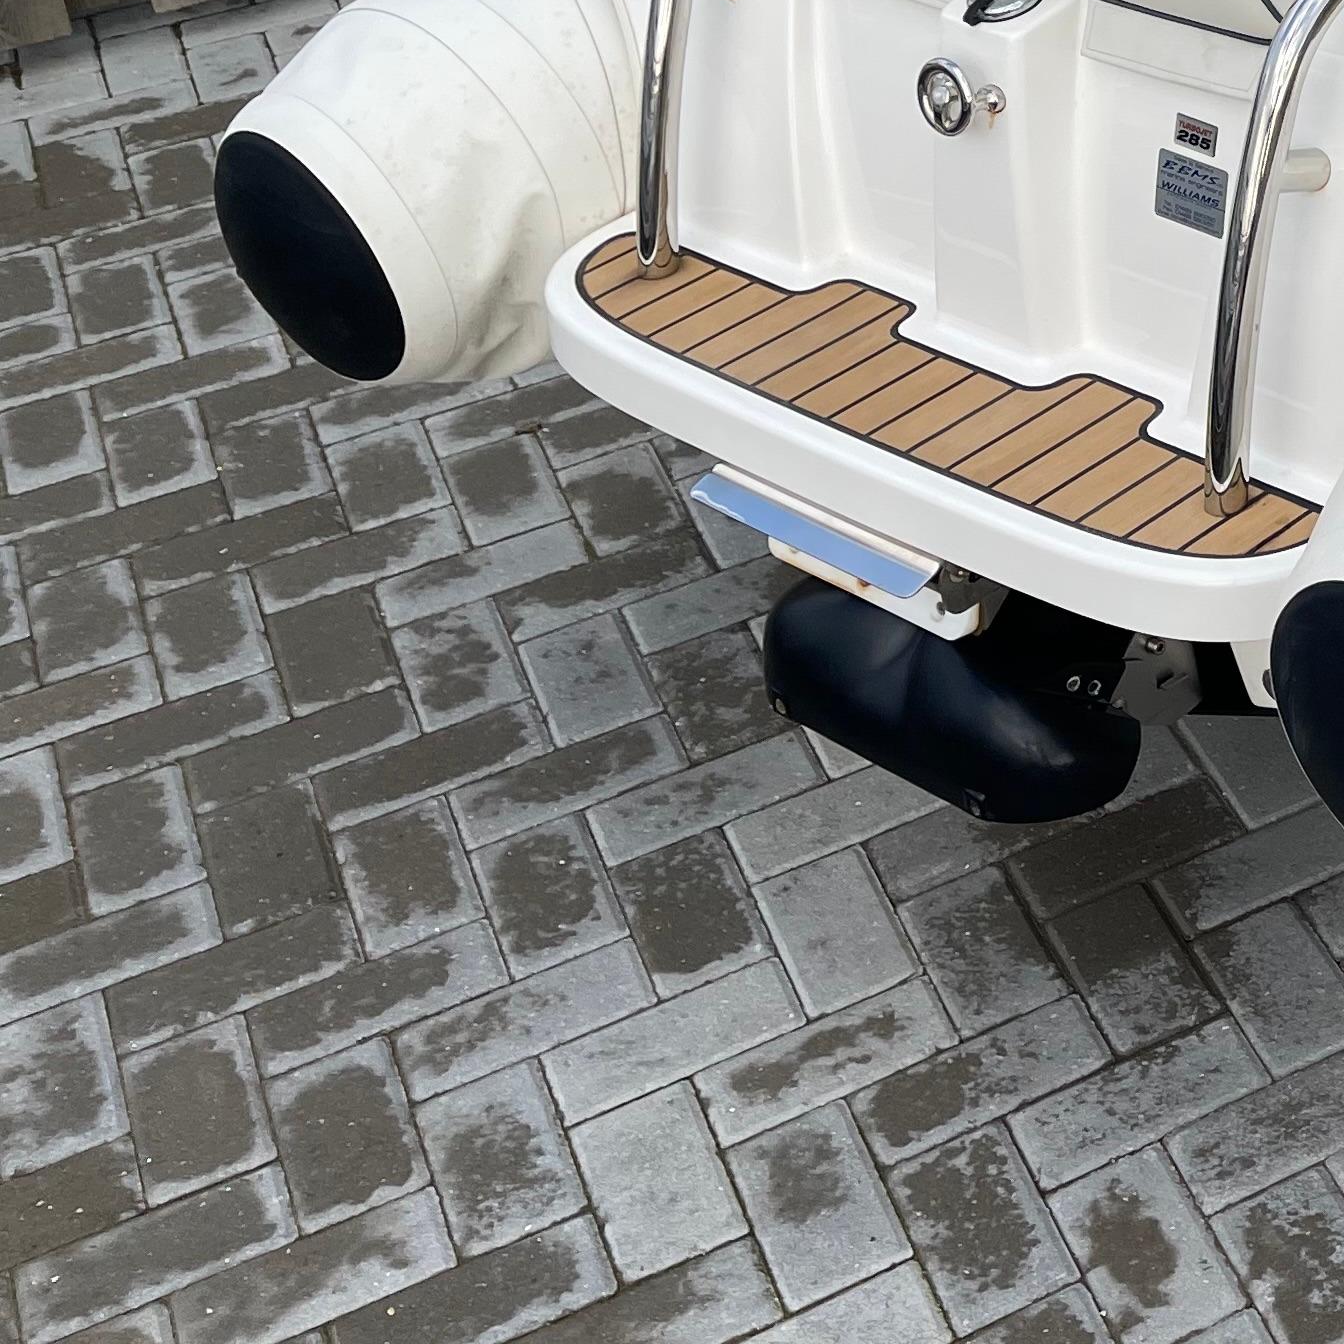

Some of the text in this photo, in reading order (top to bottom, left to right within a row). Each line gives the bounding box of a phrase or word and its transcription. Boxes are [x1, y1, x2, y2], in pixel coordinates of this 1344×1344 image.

[1176, 129, 1212, 151] 285
[1178, 119, 1213, 139] TURBOJET
[1161, 179, 1220, 209] WILLIAMS
